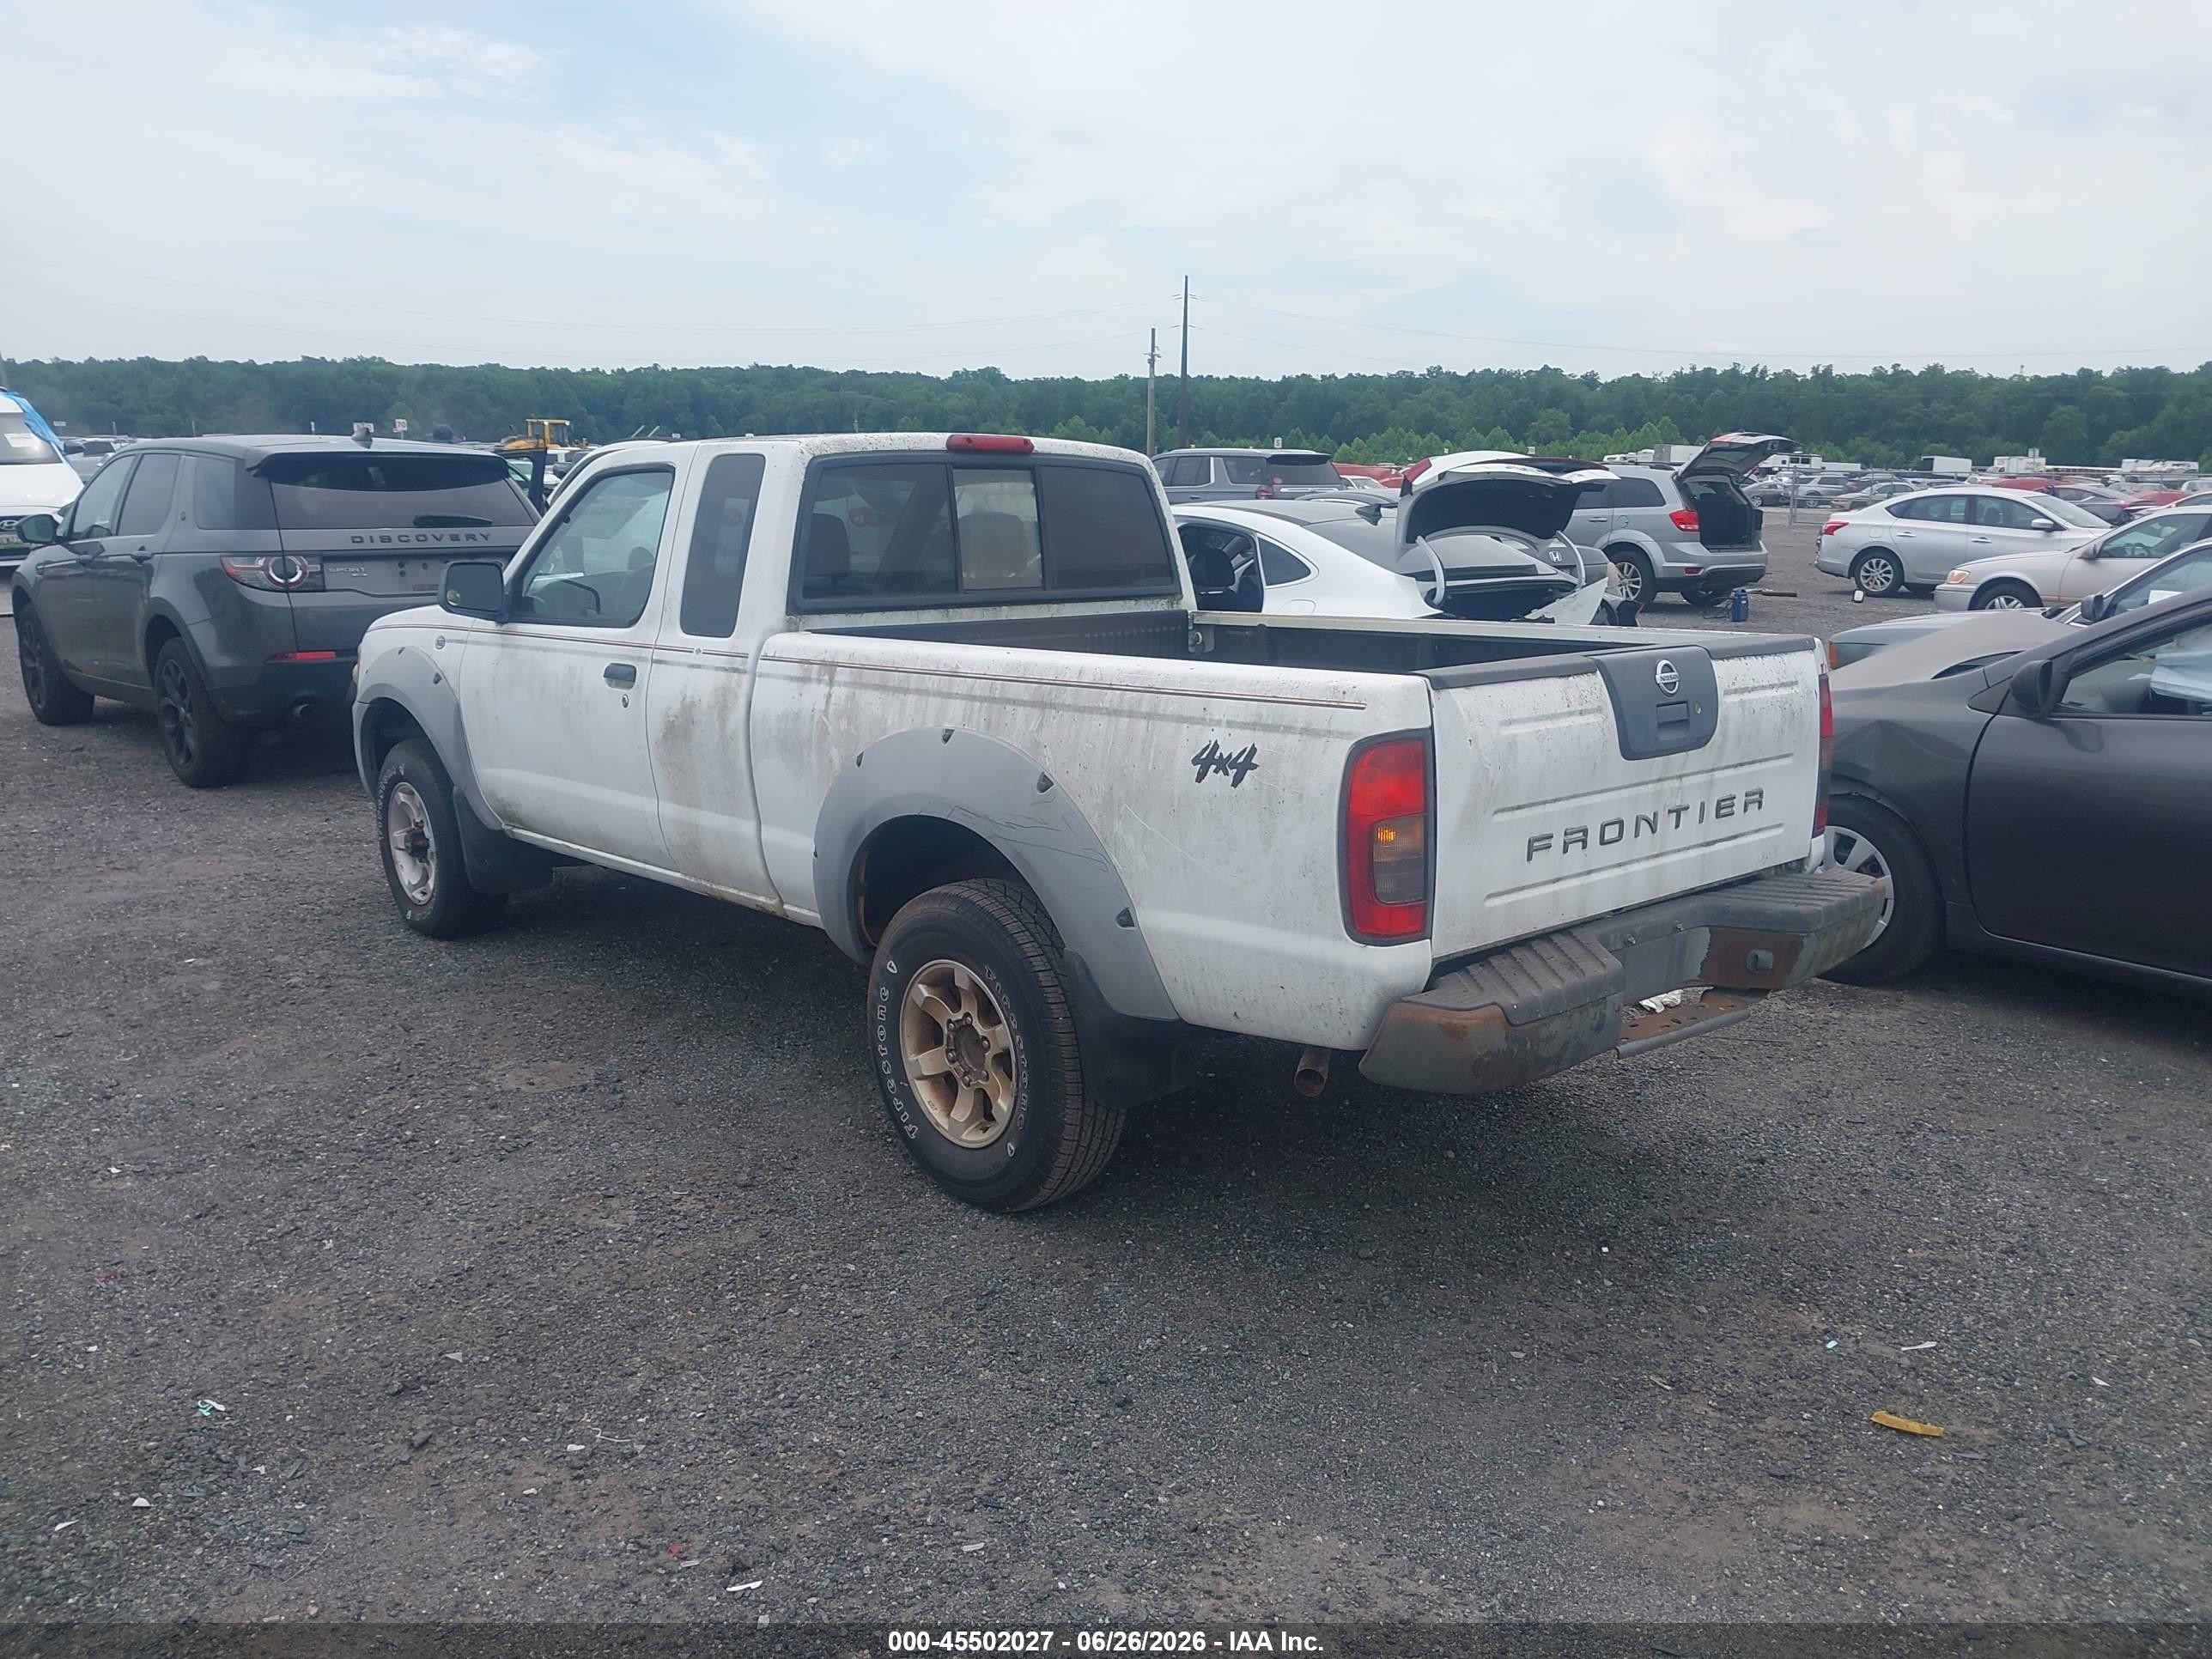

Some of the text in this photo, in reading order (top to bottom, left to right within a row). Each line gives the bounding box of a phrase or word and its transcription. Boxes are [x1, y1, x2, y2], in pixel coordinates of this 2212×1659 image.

[350, 532, 492, 544] DISCOVERY
[1527, 787, 1764, 862] FRONTIER
[877, 986, 919, 1139] Firestone
